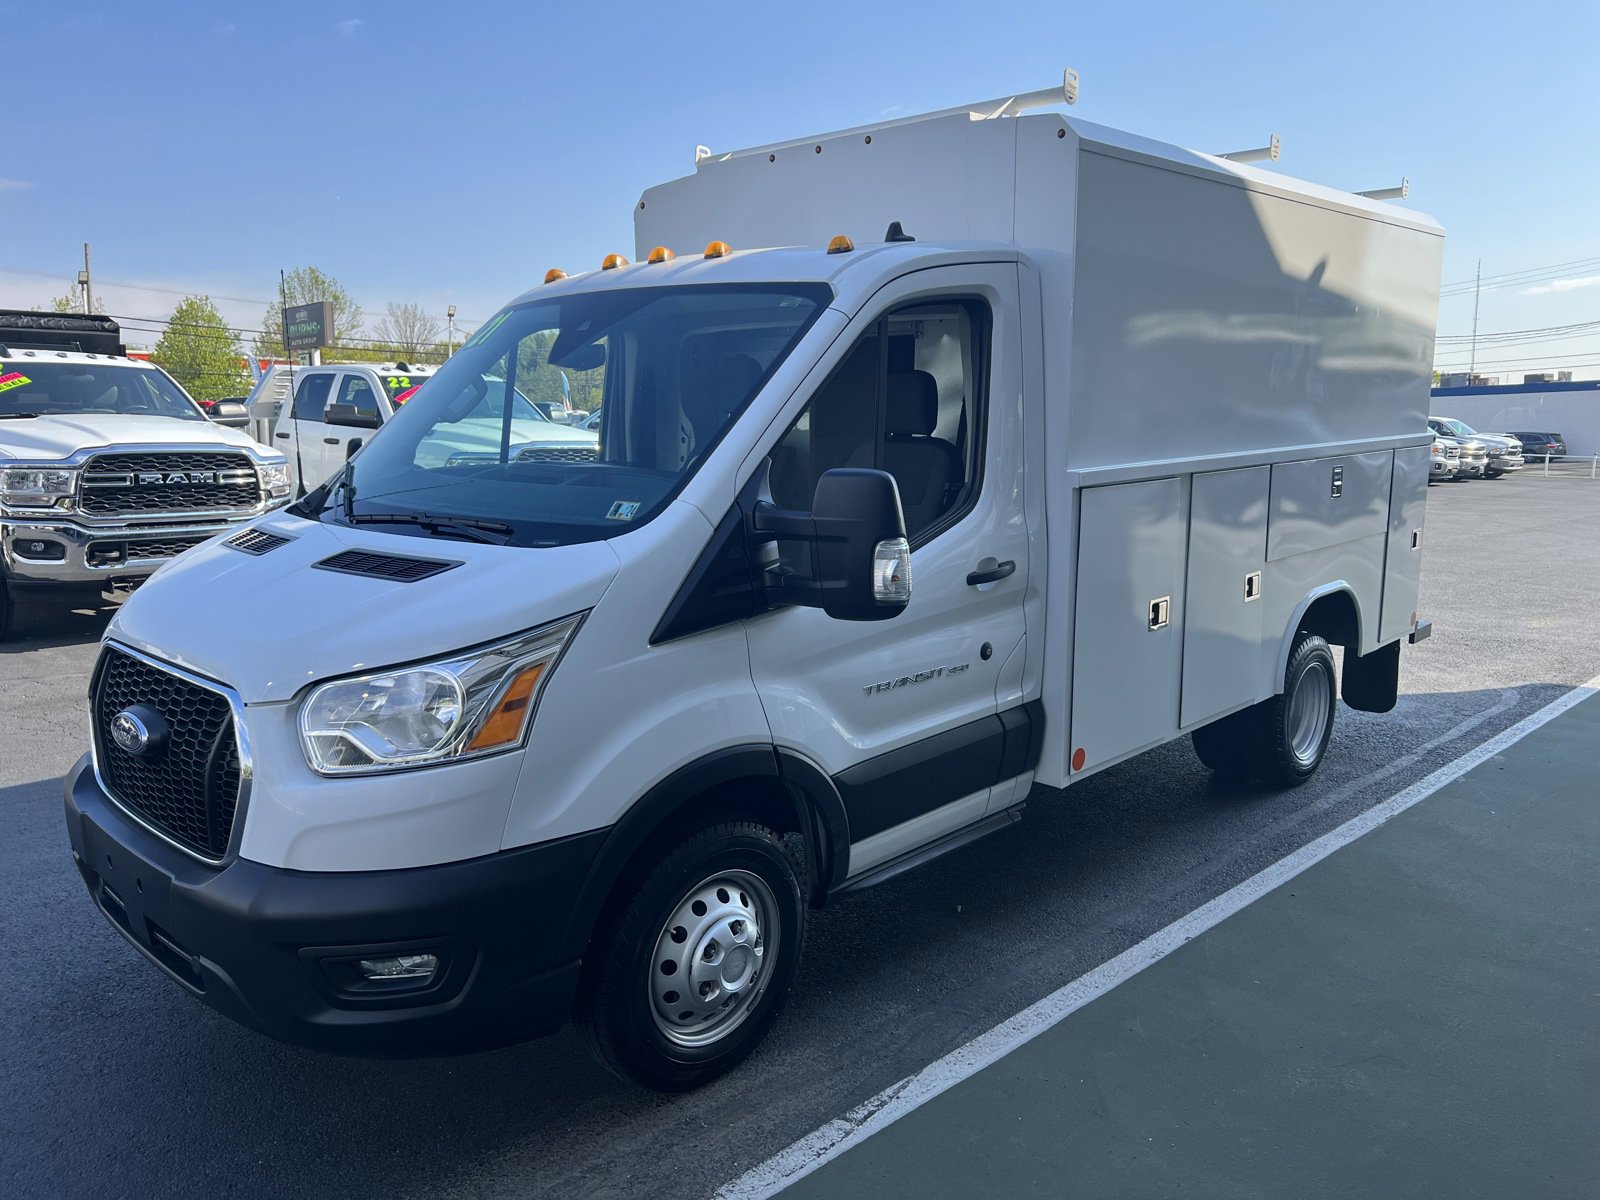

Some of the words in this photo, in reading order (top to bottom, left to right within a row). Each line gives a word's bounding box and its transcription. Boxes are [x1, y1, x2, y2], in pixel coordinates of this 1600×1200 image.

[387, 376, 411, 388] 22
[139, 473, 214, 485] RAM
[863, 665, 946, 696] TRANSIT
